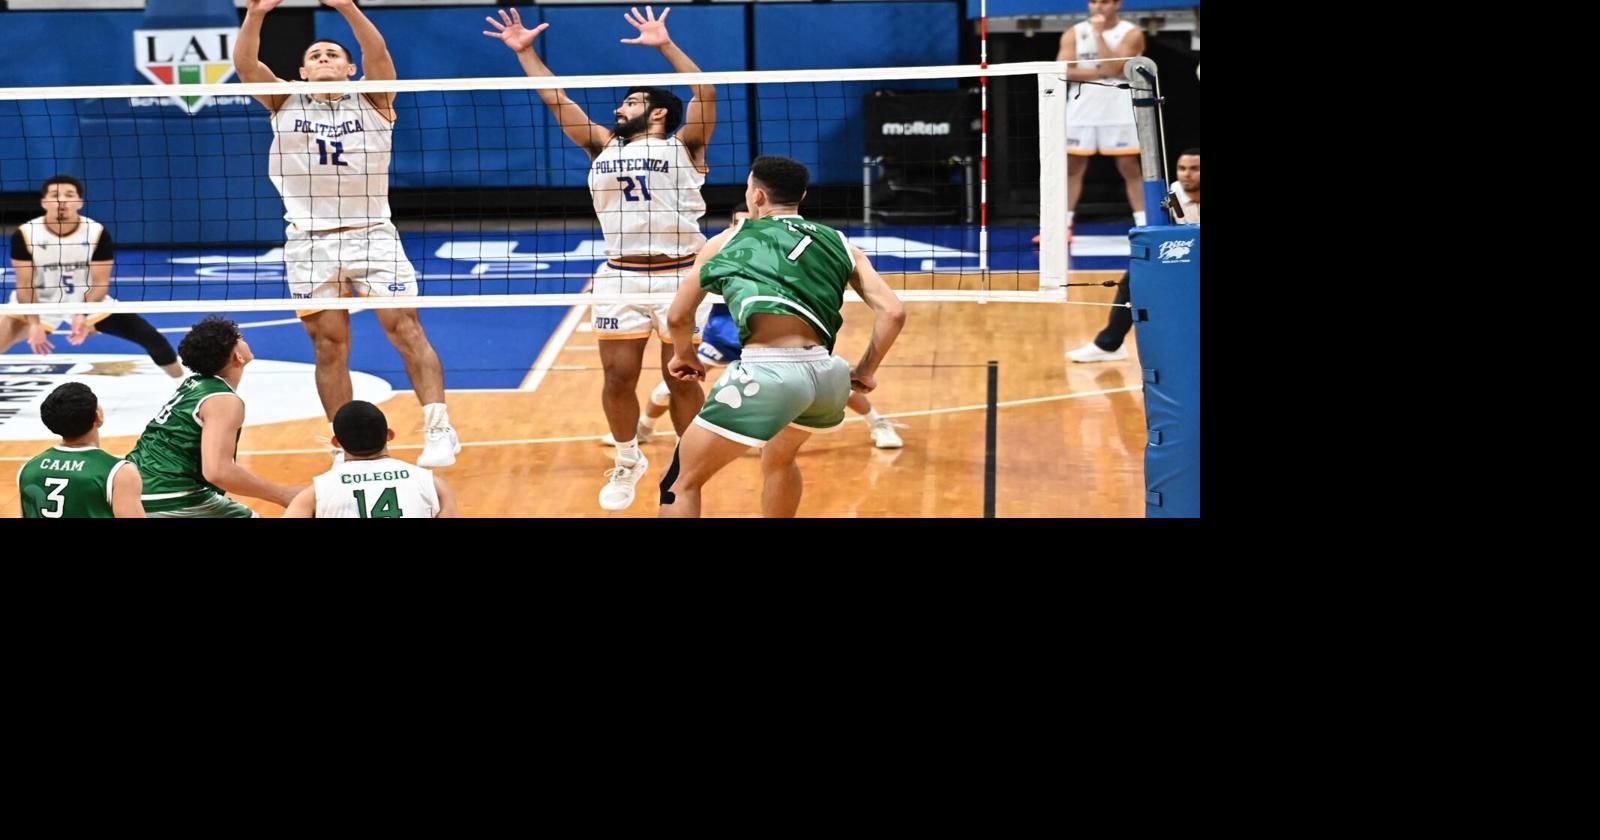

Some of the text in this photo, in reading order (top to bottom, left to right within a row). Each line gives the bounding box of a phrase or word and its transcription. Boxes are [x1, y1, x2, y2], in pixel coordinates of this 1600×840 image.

[145, 33, 230, 63] LAI
[882, 121, 950, 135] molten
[315, 138, 348, 166] 12
[595, 158, 670, 174] POLITECNICA
[616, 175, 652, 202] 21
[62, 275, 75, 294] 5
[40, 458, 86, 472] CAAM
[340, 469, 410, 485] COLEGIO
[41, 477, 69, 518] 3
[352, 486, 404, 518] 14
